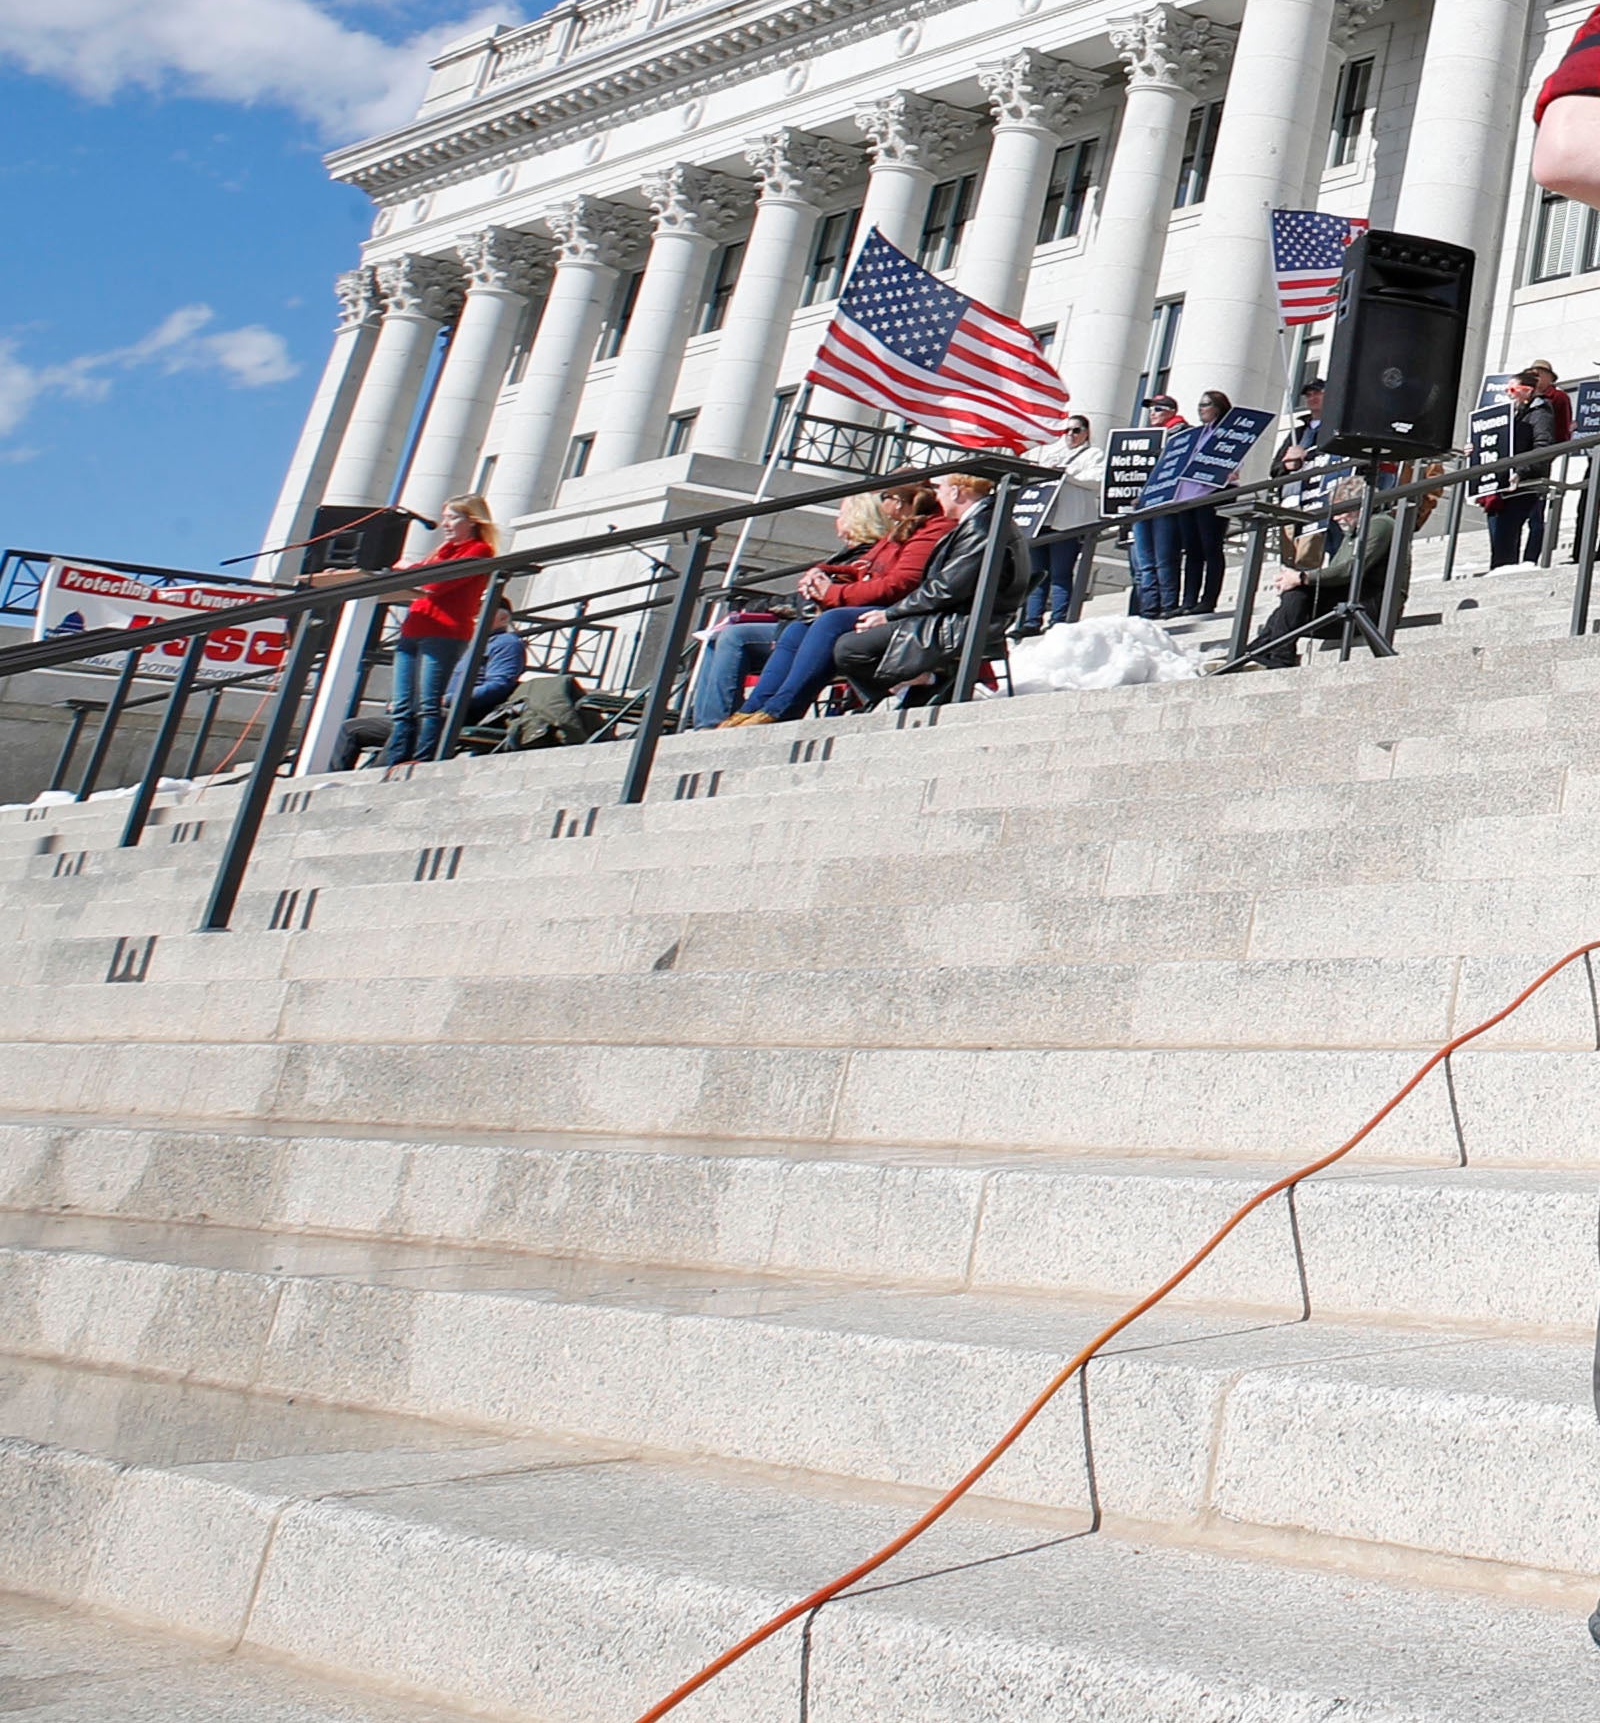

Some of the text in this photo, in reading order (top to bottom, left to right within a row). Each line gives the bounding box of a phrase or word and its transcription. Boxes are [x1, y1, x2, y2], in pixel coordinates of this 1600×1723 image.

[1472, 415, 1508, 434] Women
[1128, 438, 1150, 450] Will
[1480, 434, 1498, 448] For
[1111, 455, 1131, 467] Not
[1132, 454, 1147, 466] Be
[1480, 451, 1498, 465] The
[1113, 470, 1148, 482] Victim
[64, 571, 153, 601] Protecting
